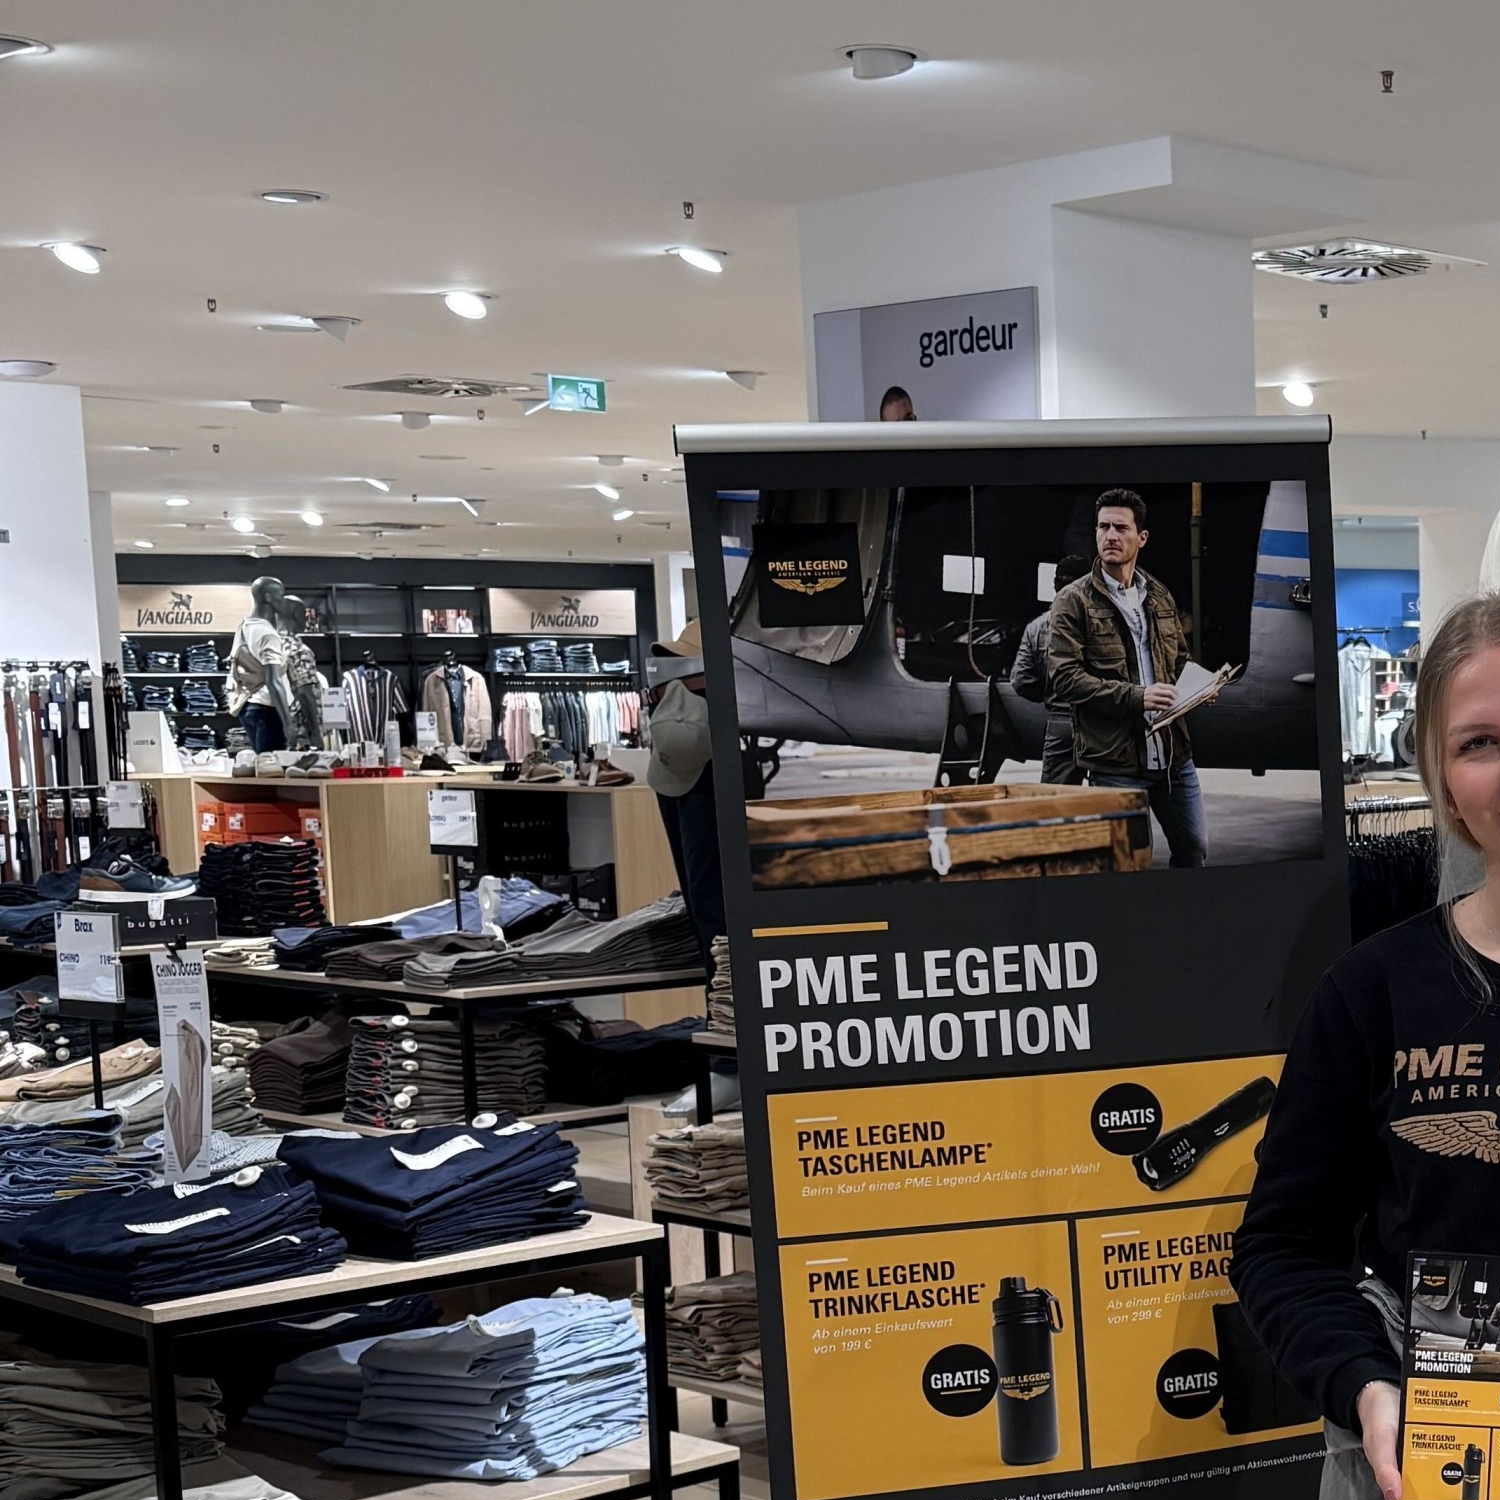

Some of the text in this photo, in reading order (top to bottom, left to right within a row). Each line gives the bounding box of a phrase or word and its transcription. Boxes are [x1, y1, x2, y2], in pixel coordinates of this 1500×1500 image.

[919, 316, 1018, 368] gardeur
[768, 559, 848, 572] PME LEGEND
[137, 609, 213, 627] VANGUARD
[530, 612, 599, 630] VANGUARD
[74, 918, 93, 933] Brax
[127, 916, 190, 928] bugatti
[59, 952, 80, 963] CHINO
[156, 962, 203, 977] CHINO JOGGER
[758, 941, 1098, 1008] PME LEGEND
[763, 1003, 1091, 1073] PROMOTION
[1394, 1043, 1485, 1088] PME
[1098, 1107, 1155, 1127] GRATIS
[797, 1121, 945, 1151] PME LEGEND
[802, 1162, 1100, 1197] Beim Kauf eines PME Legend Artikels deiner Wahl
[1103, 1231, 1235, 1265] PME LEGEND
[808, 1260, 955, 1293] PME LEGEND
[1104, 1263, 1183, 1290] UTILITY
[1106, 1299, 1123, 1310] Ab
[1126, 1297, 1160, 1308] einem
[1107, 1308, 1162, 1324] von 299 €
[812, 1317, 953, 1339] Ab einem Einkaufswert
[813, 1338, 872, 1354] von 199 €
[1415, 1350, 1473, 1363] PME LEGEND
[1414, 1361, 1471, 1374] PROMOTION
[930, 1368, 990, 1389] GRATIS
[1018, 1371, 1051, 1383] LEGEND
[1163, 1371, 1218, 1393] GRATIS
[1042, 1486, 1104, 1500] verschiedener
[1106, 1476, 1170, 1492] Artikelgruppen
[1172, 1473, 1188, 1483] und
[1190, 1471, 1205, 1480] nur
[1207, 1465, 1231, 1479] gültig
[1232, 1464, 1246, 1473] am
